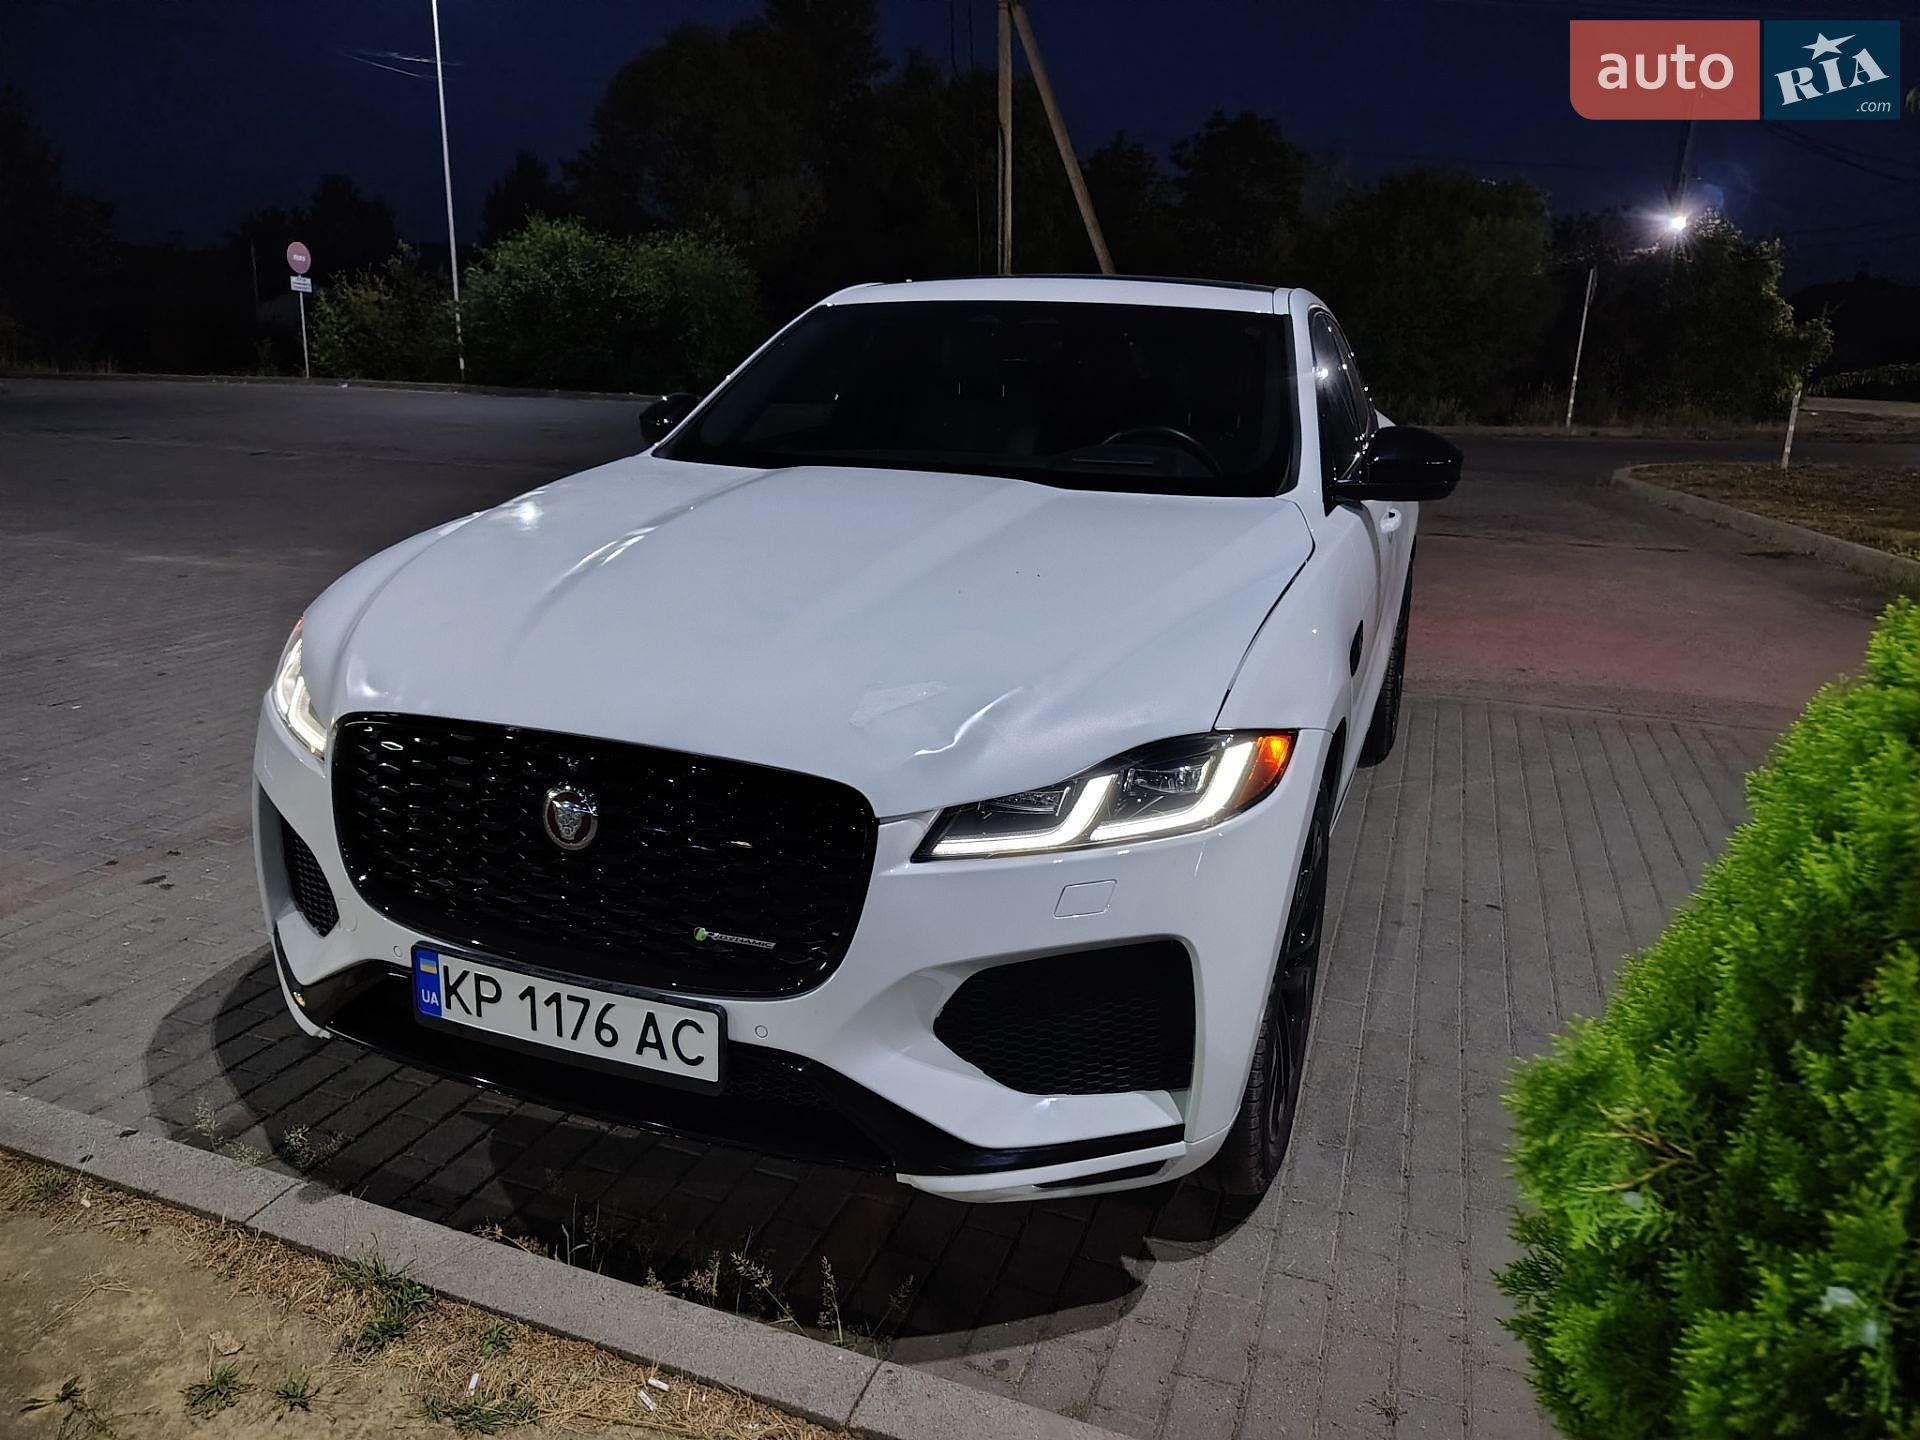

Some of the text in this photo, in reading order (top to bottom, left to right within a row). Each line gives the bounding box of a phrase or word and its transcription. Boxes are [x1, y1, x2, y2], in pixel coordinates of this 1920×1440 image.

[421, 988, 439, 1007] UA
[442, 965, 705, 1067] KP 1176 AC
